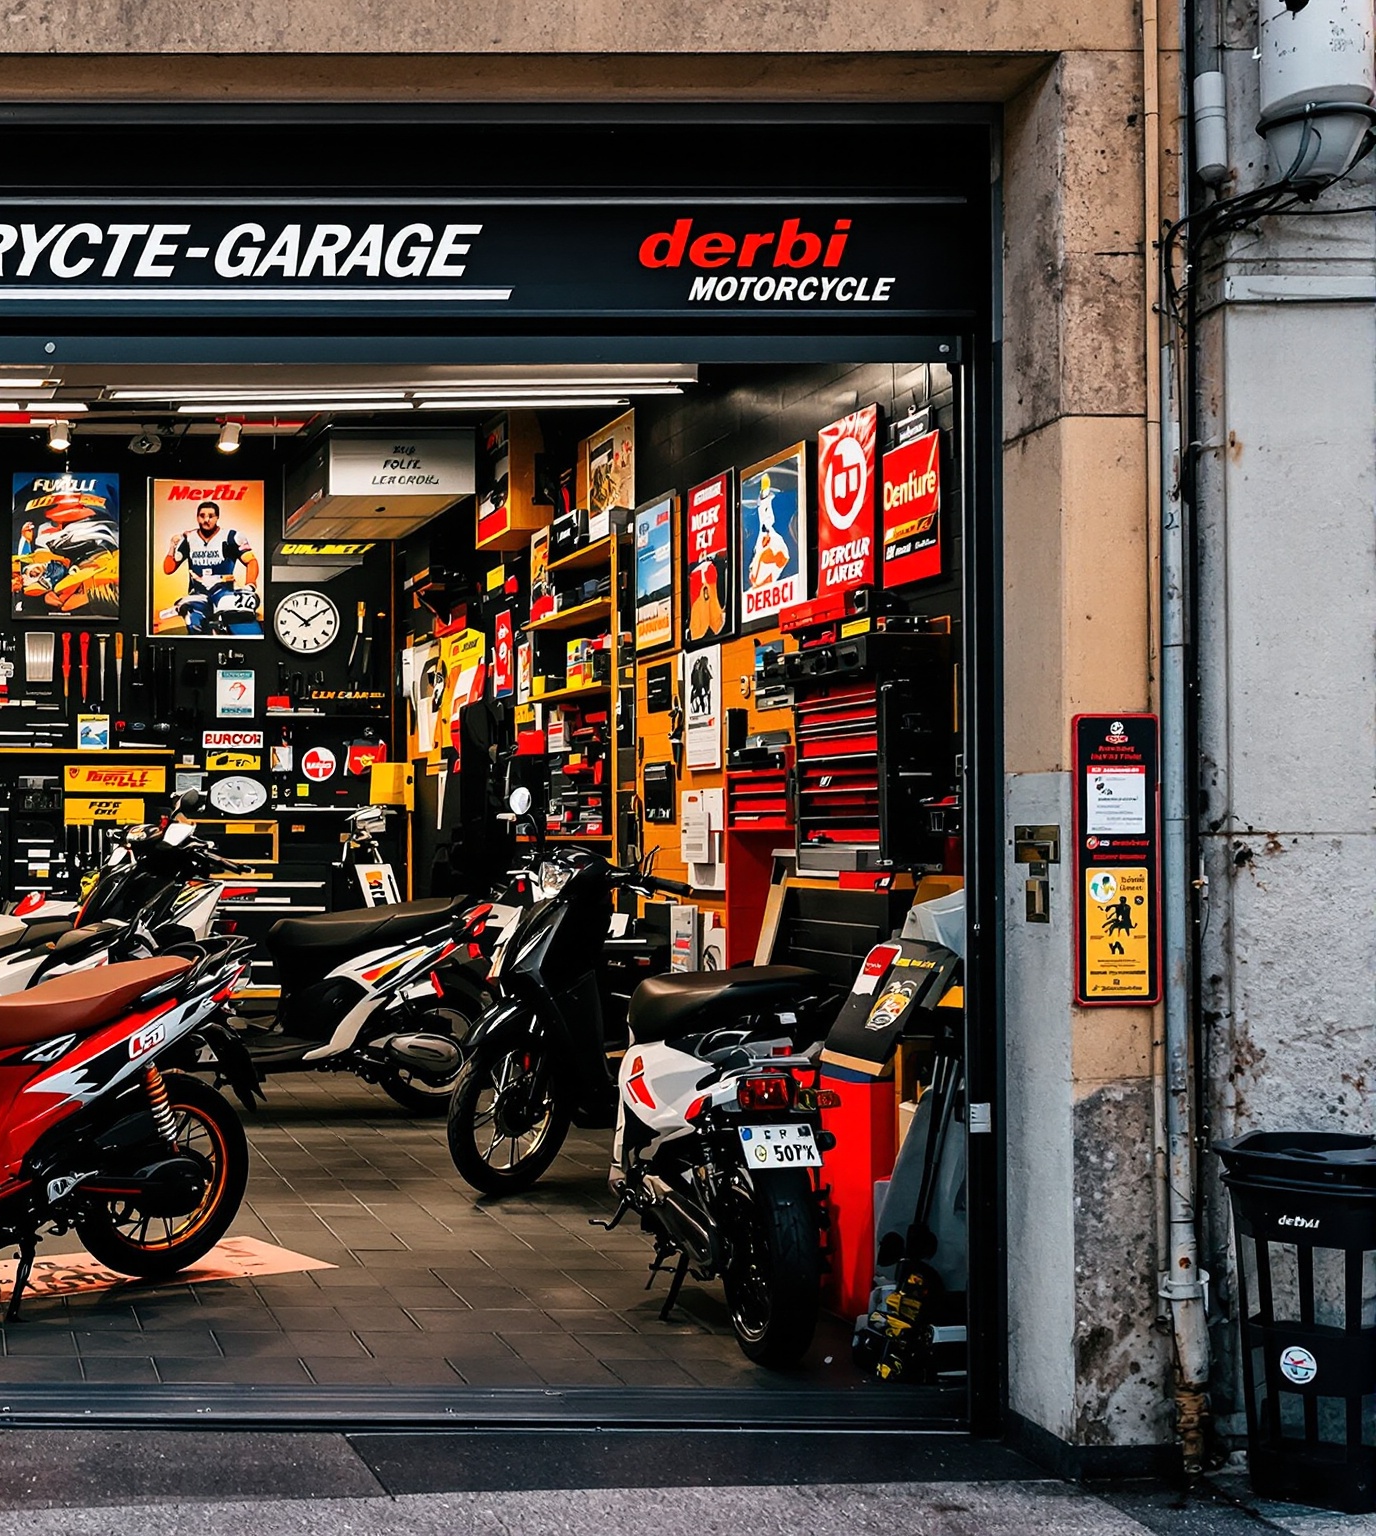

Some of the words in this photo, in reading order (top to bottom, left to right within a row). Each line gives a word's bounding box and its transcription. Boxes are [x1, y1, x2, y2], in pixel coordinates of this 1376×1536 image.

[638, 218, 853, 268] derbi
[688, 276, 896, 301] MOTORCYCLE
[746, 581, 793, 614] DERBCI
